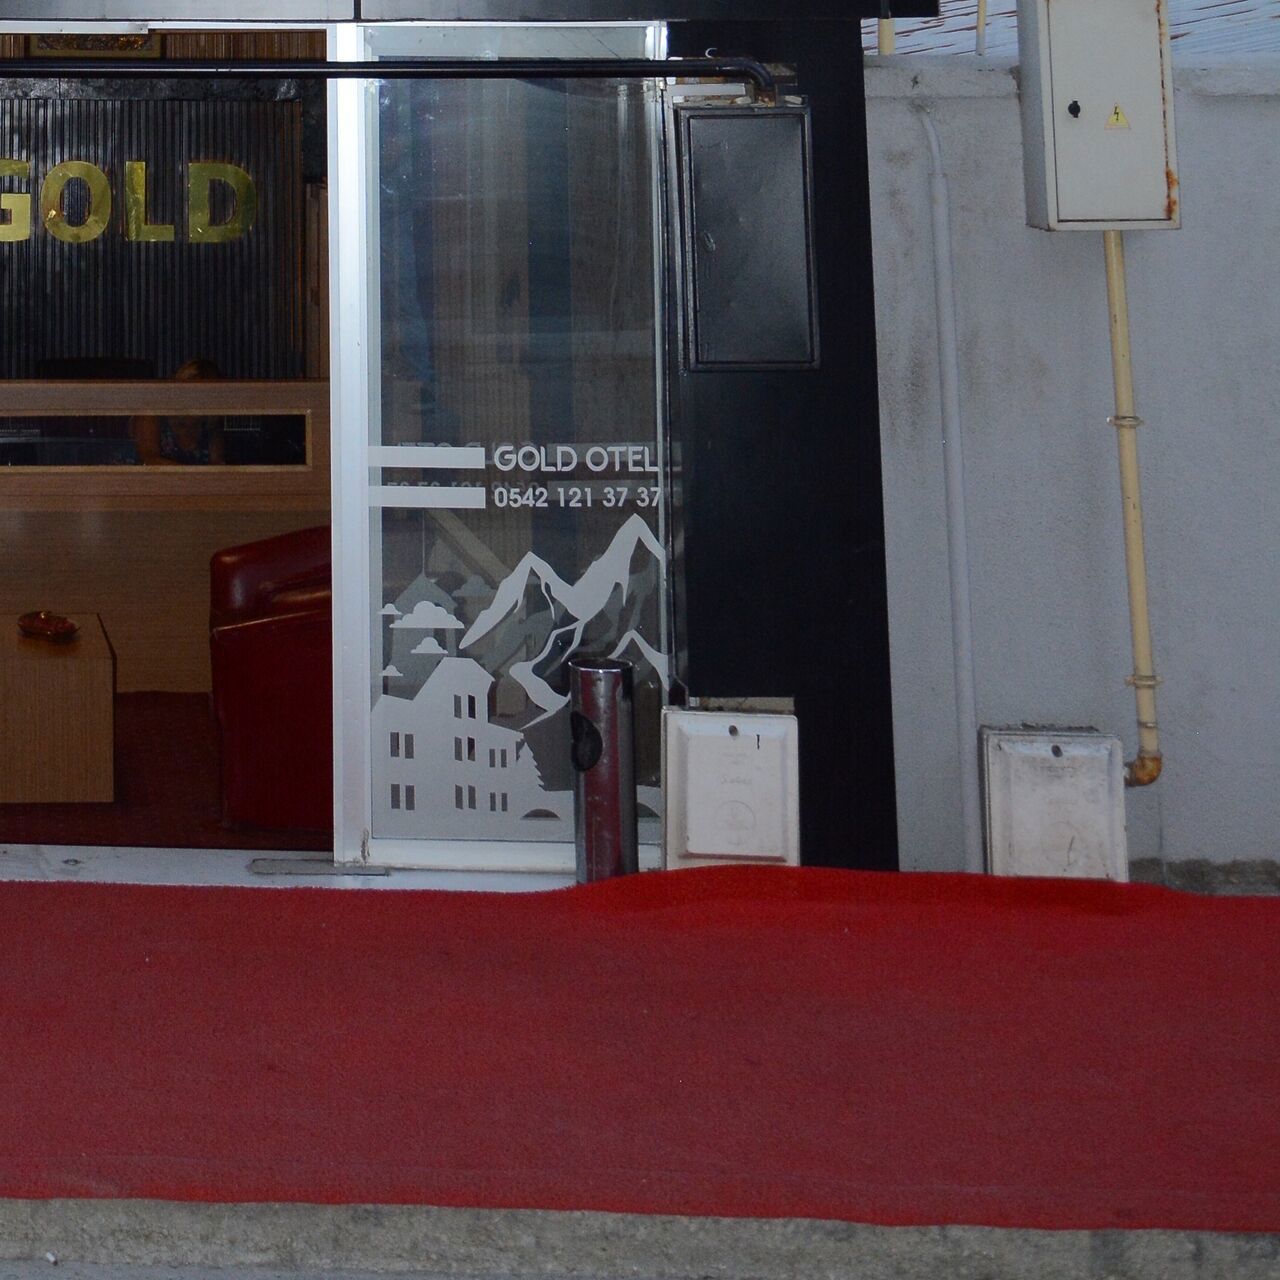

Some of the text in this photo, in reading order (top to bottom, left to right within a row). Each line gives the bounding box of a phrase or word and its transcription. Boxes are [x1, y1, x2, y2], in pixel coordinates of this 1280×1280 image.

[493, 445, 660, 472] GOLD OTEL
[493, 486, 662, 508] 0542 121 37 37
